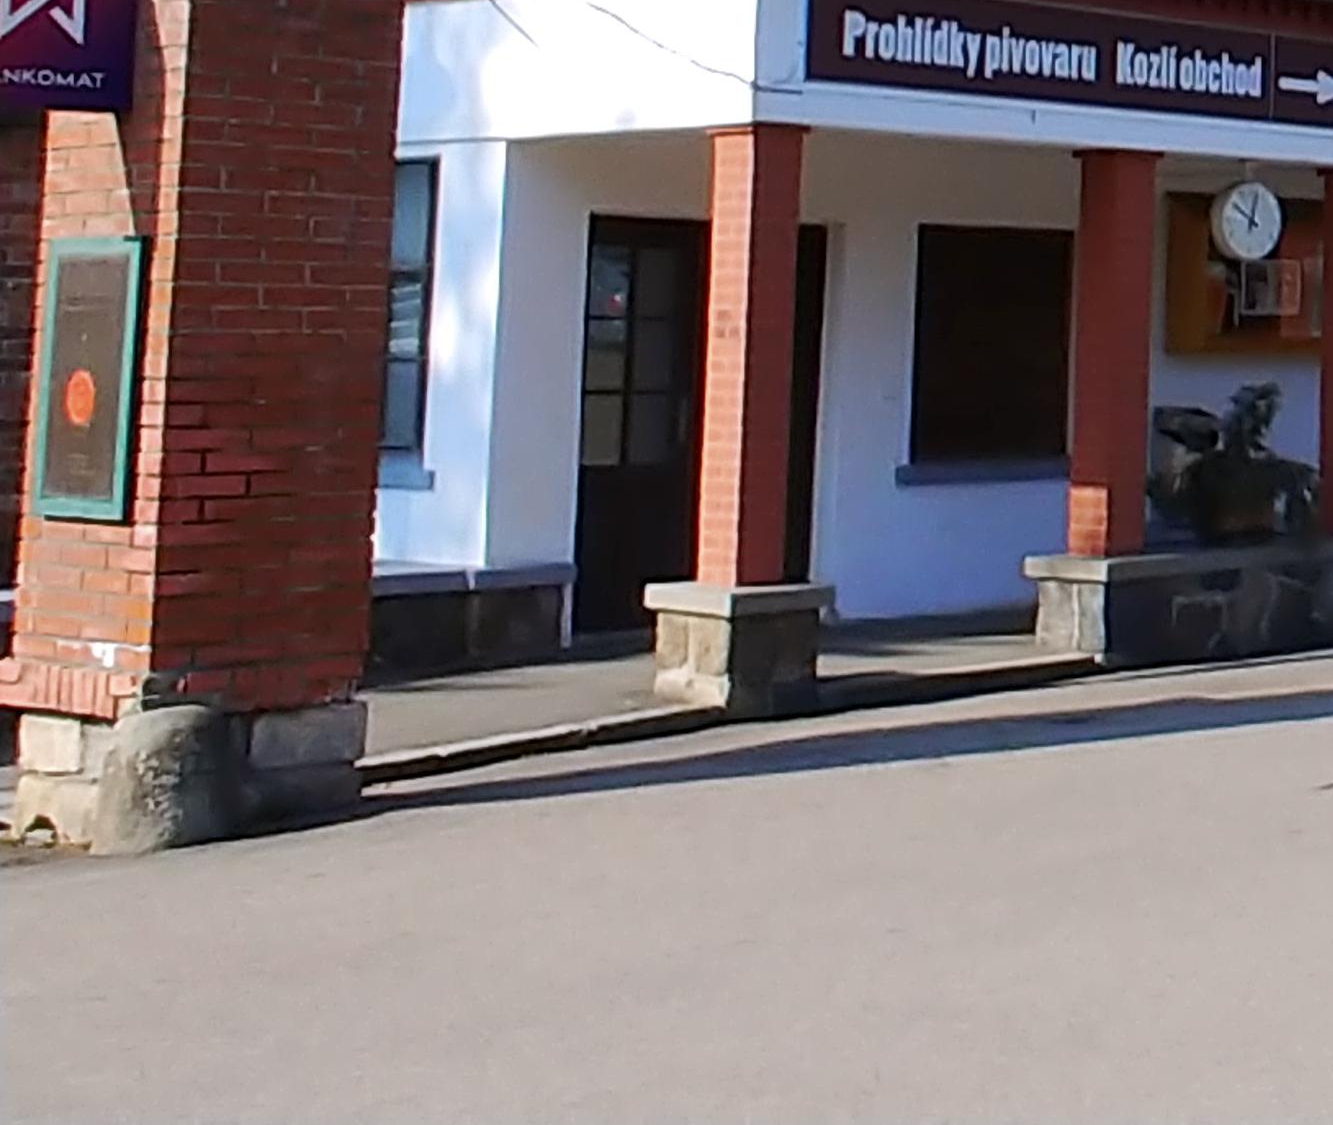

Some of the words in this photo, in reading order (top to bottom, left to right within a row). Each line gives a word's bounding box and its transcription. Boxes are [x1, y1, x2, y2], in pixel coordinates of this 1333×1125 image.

[842, 7, 981, 79] Prohlídky
[985, 25, 1098, 82] pivovaru
[1177, 50, 1263, 100] obchod
